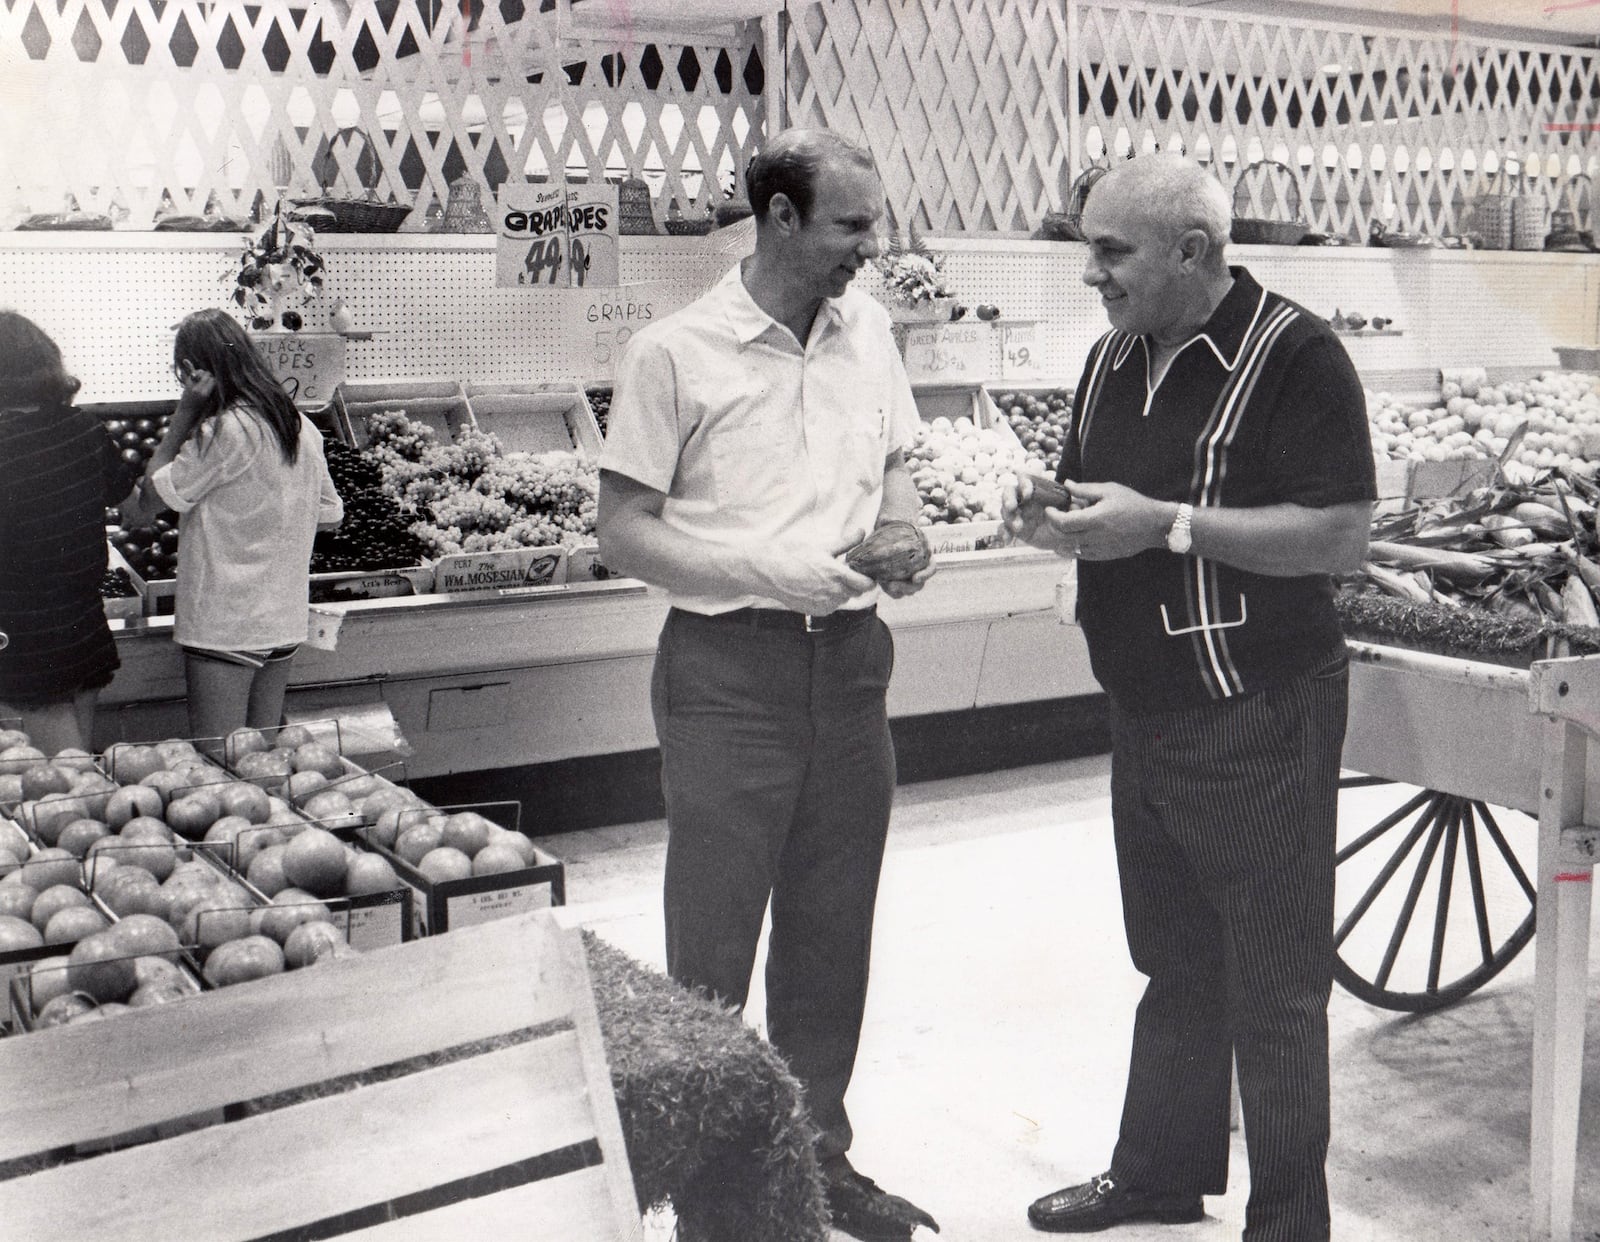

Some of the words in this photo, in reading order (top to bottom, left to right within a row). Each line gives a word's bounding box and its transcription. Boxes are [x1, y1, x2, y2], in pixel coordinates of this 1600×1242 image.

[587, 303, 653, 322] GRAPES
[910, 333, 937, 346] GREEN
[478, 562, 495, 571] The
[467, 568, 525, 585] MOSESIAN
[361, 580, 380, 588] Art's
